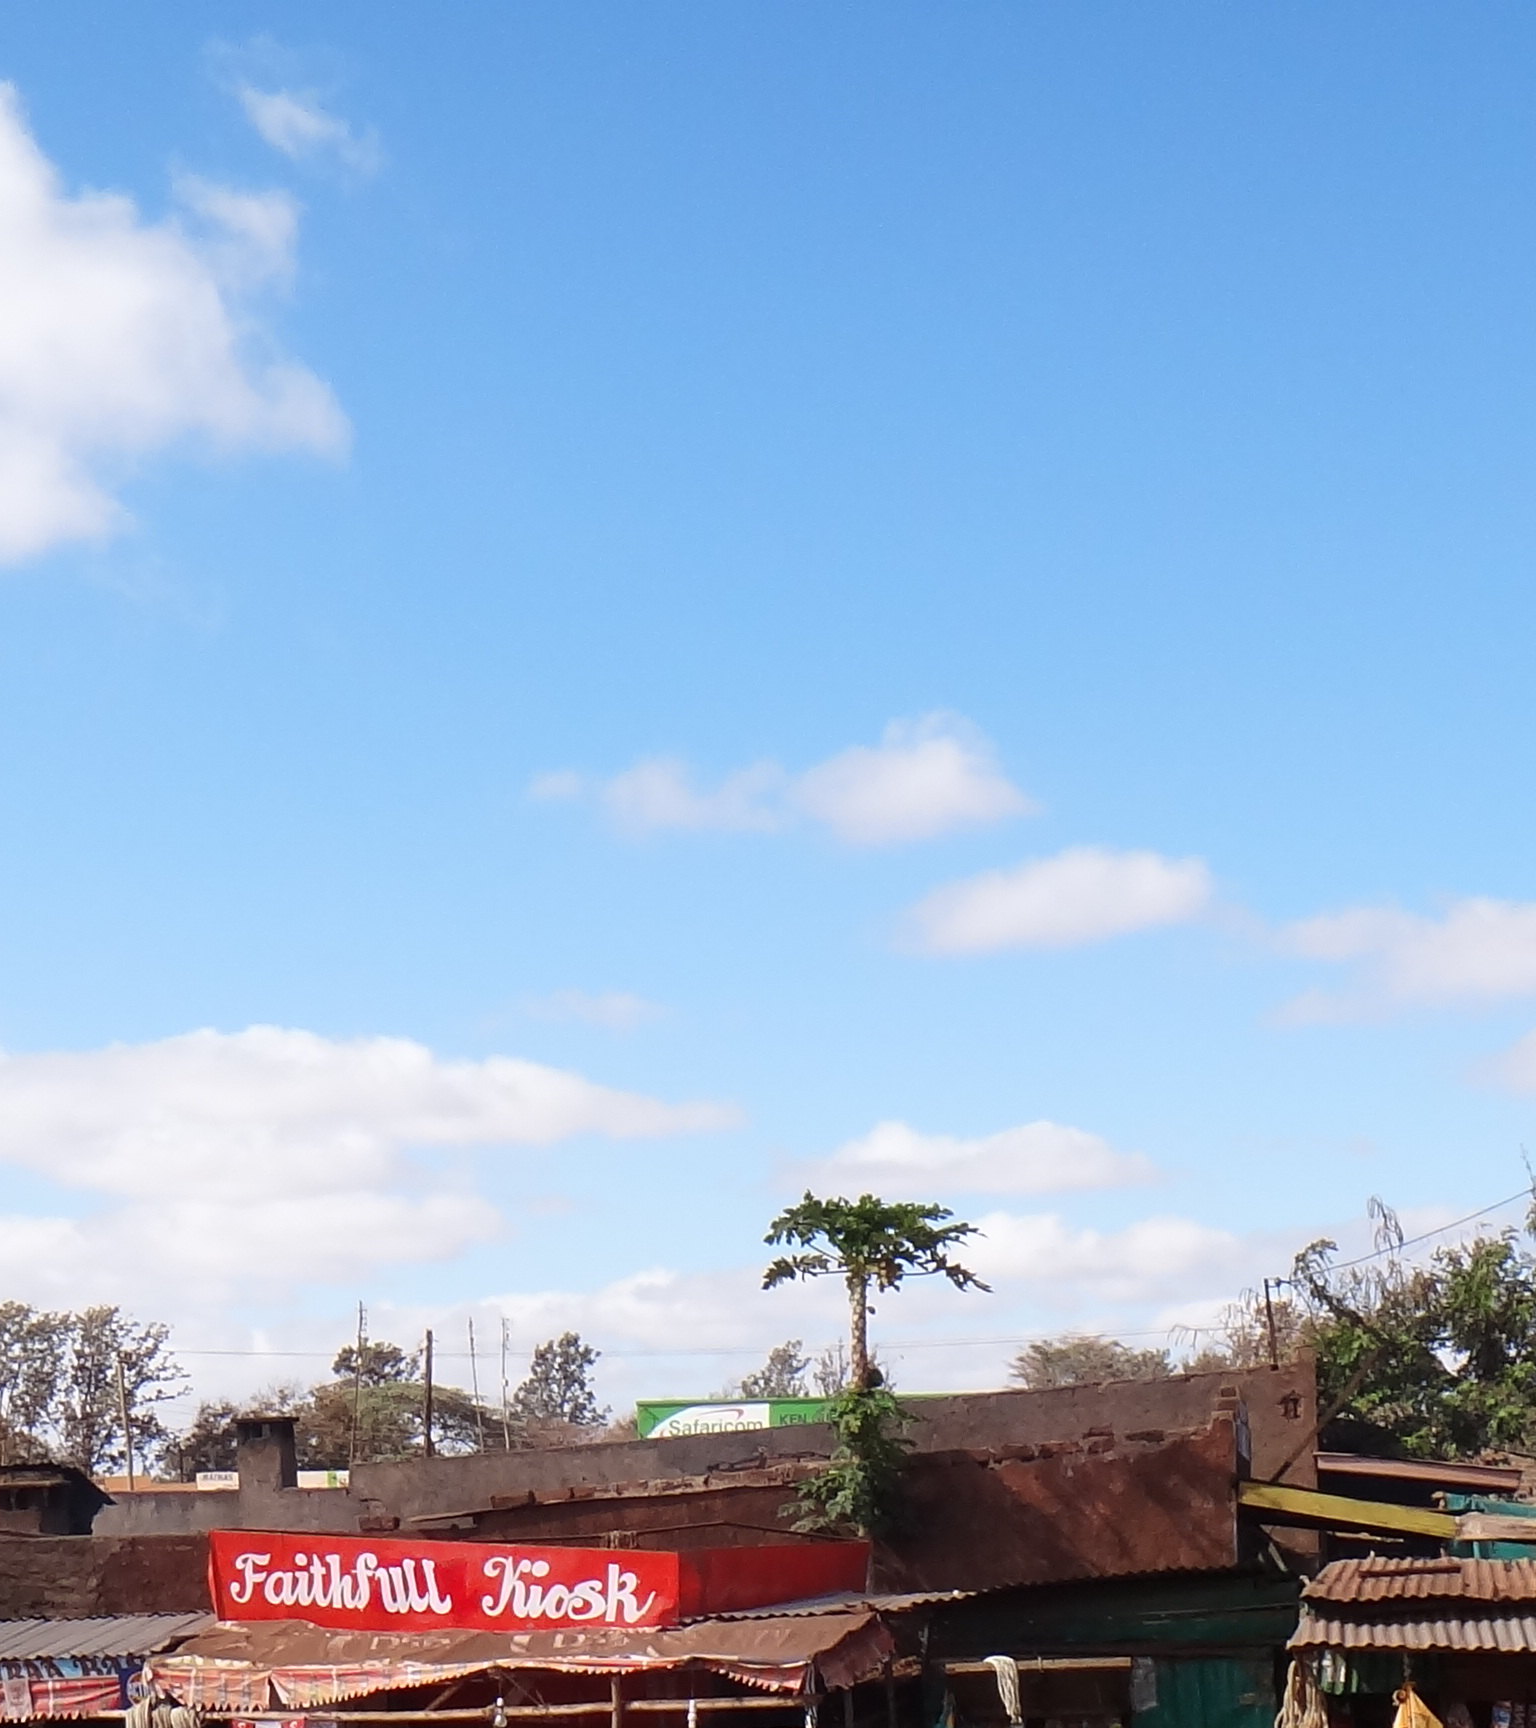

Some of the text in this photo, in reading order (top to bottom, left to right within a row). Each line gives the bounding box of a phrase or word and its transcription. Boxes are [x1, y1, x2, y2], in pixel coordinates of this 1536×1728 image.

[669, 1419, 763, 1436] Safaricom
[230, 1552, 656, 1623] Faithfull Kiosk
